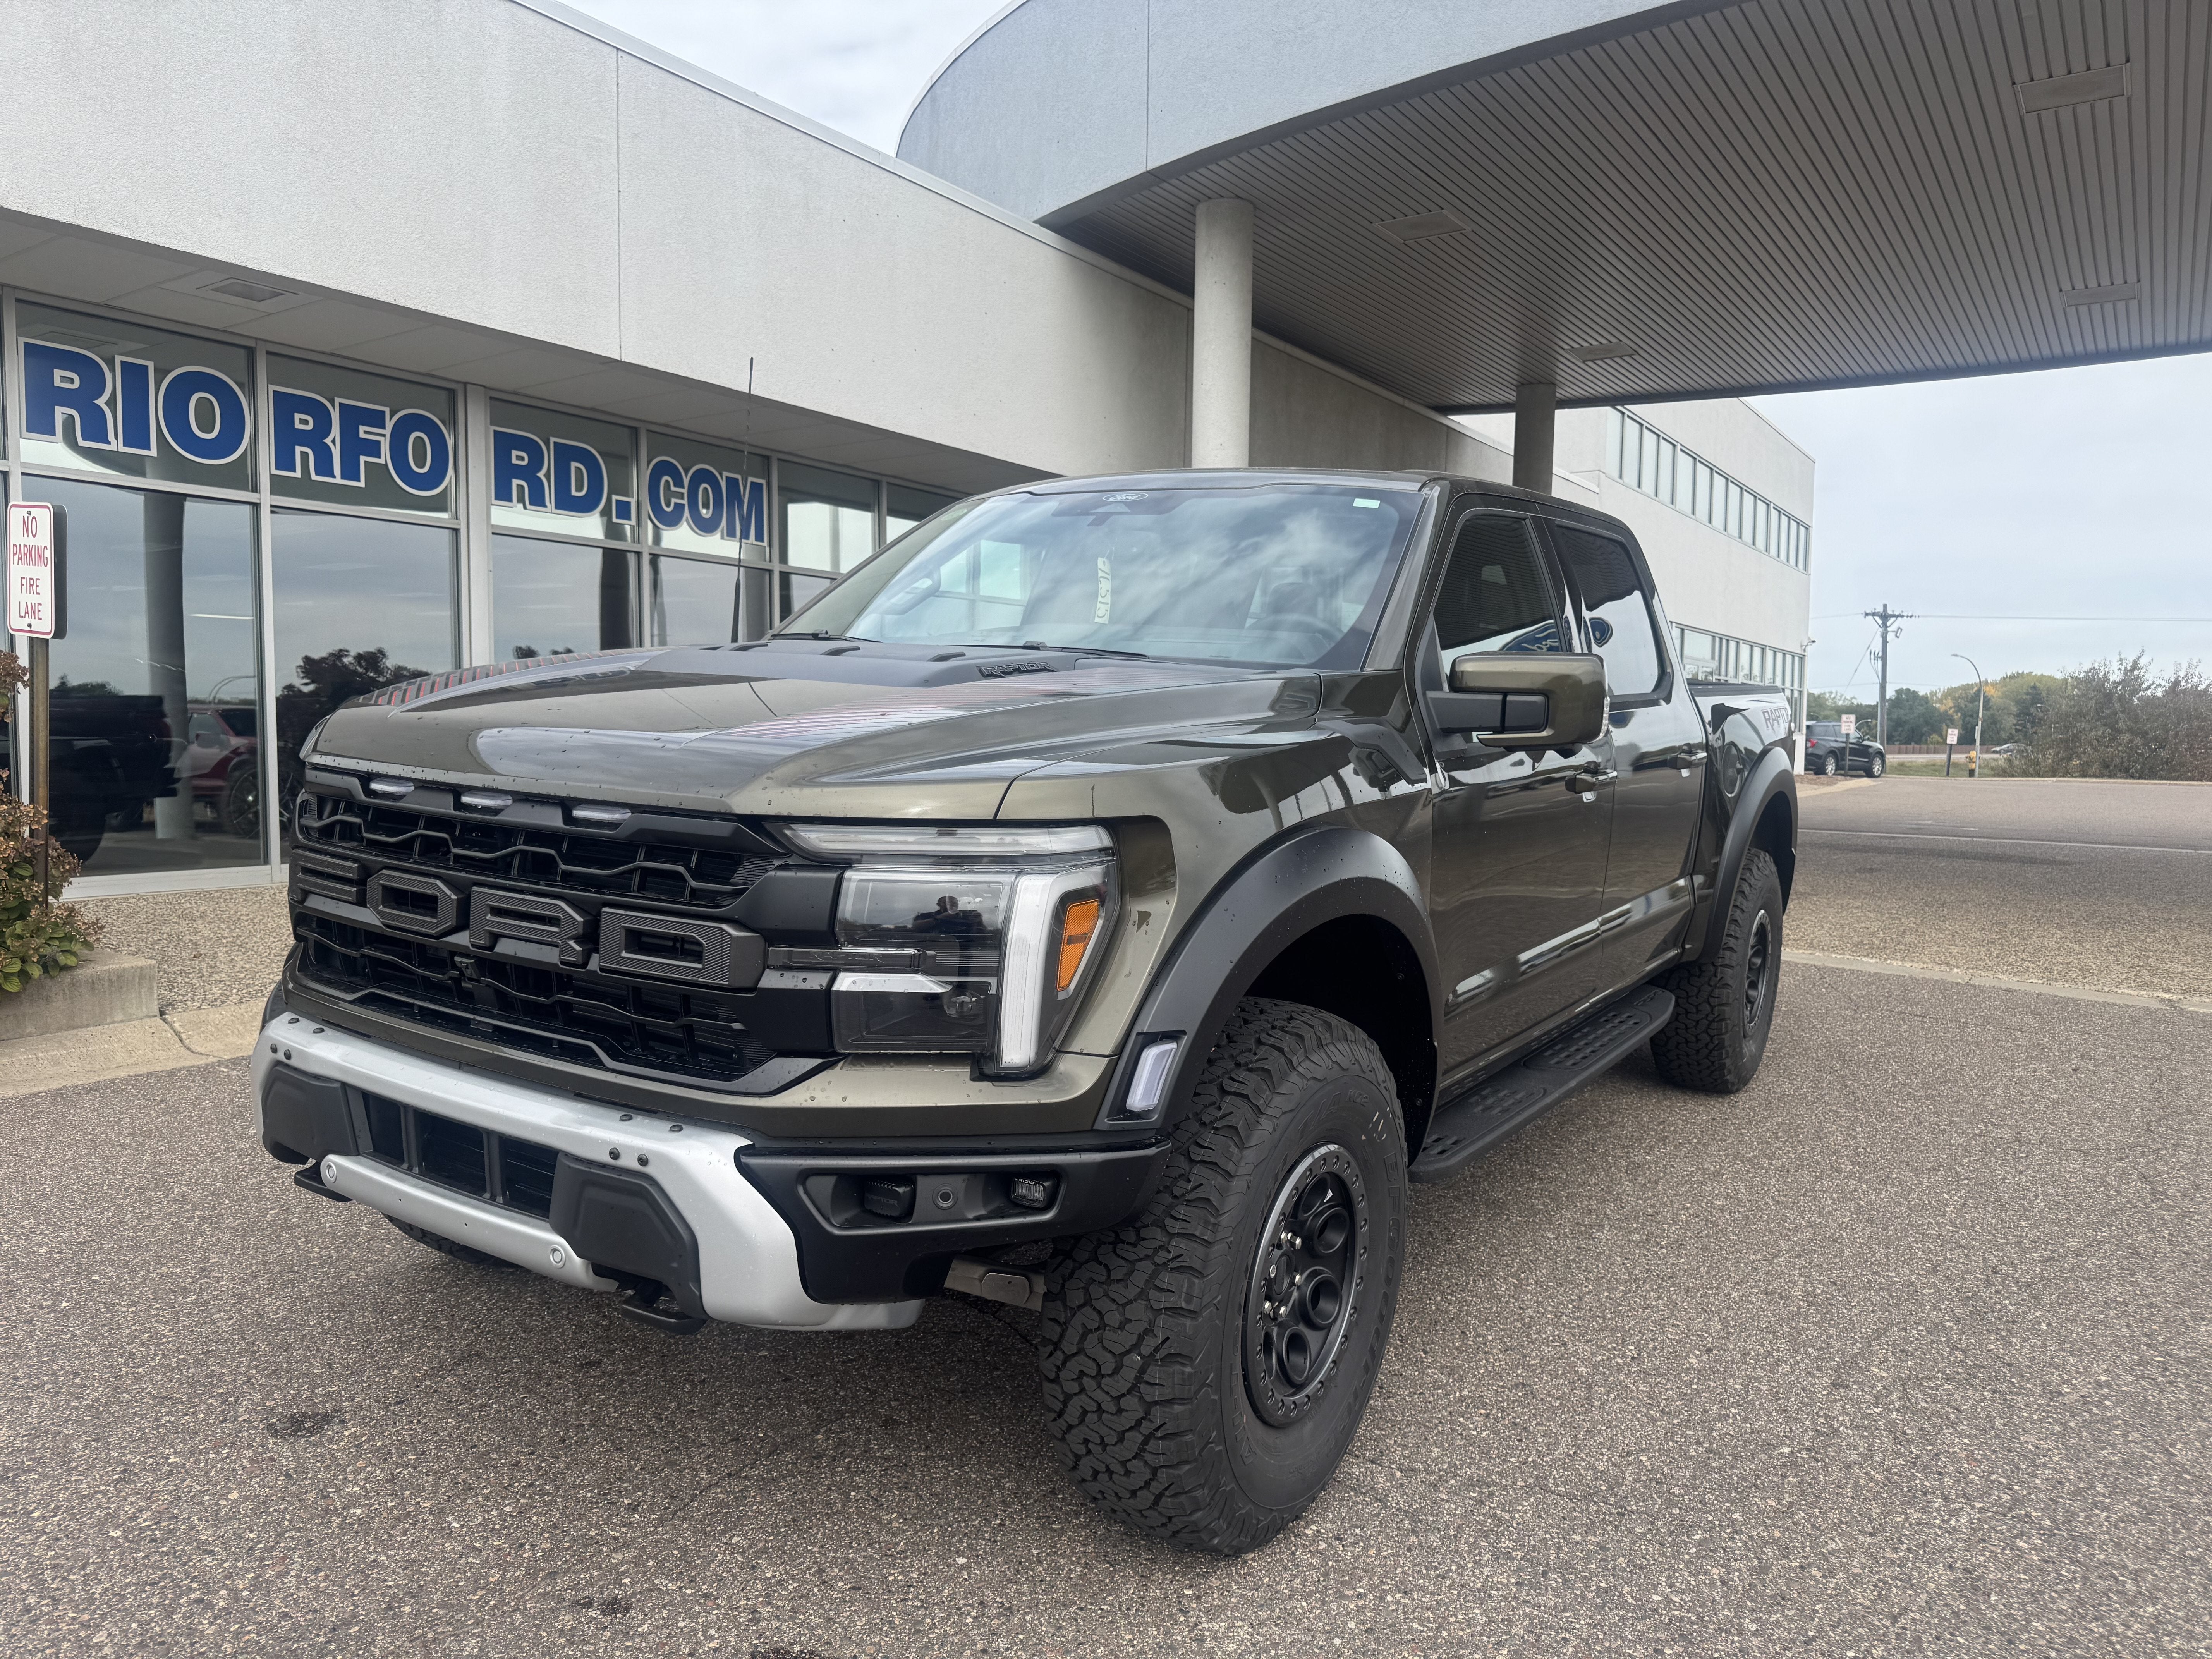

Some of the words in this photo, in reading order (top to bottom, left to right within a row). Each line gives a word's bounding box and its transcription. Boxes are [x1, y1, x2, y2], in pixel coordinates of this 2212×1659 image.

[23, 515, 38, 538] NO
[12, 544, 48, 567] PARKING
[21, 577, 41, 595] FIRE
[19, 601, 43, 620] LANE
[979, 661, 1058, 678] RAPTOR
[288, 848, 766, 988] FORD
